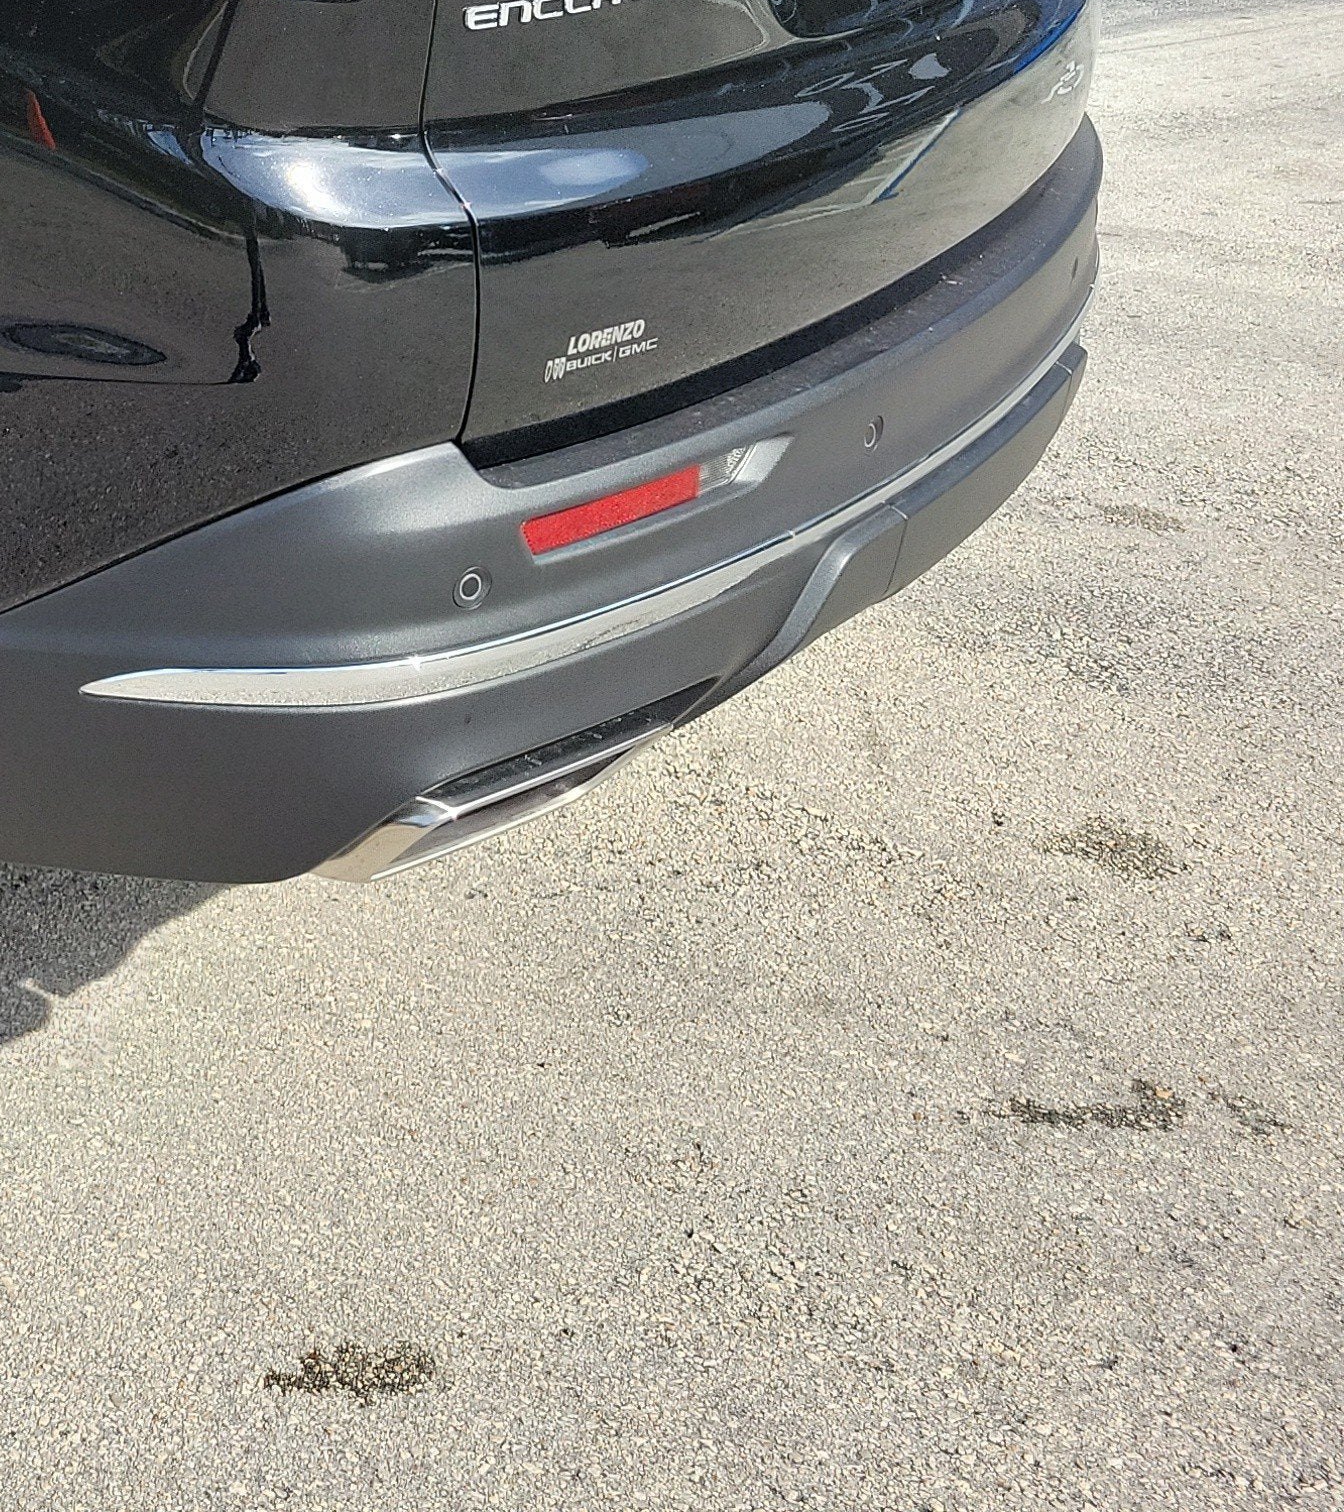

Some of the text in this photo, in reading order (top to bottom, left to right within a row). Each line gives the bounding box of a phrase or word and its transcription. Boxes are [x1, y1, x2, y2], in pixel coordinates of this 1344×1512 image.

[566, 337, 659, 372] BUICK GMC
[567, 319, 646, 356] LORENZO
